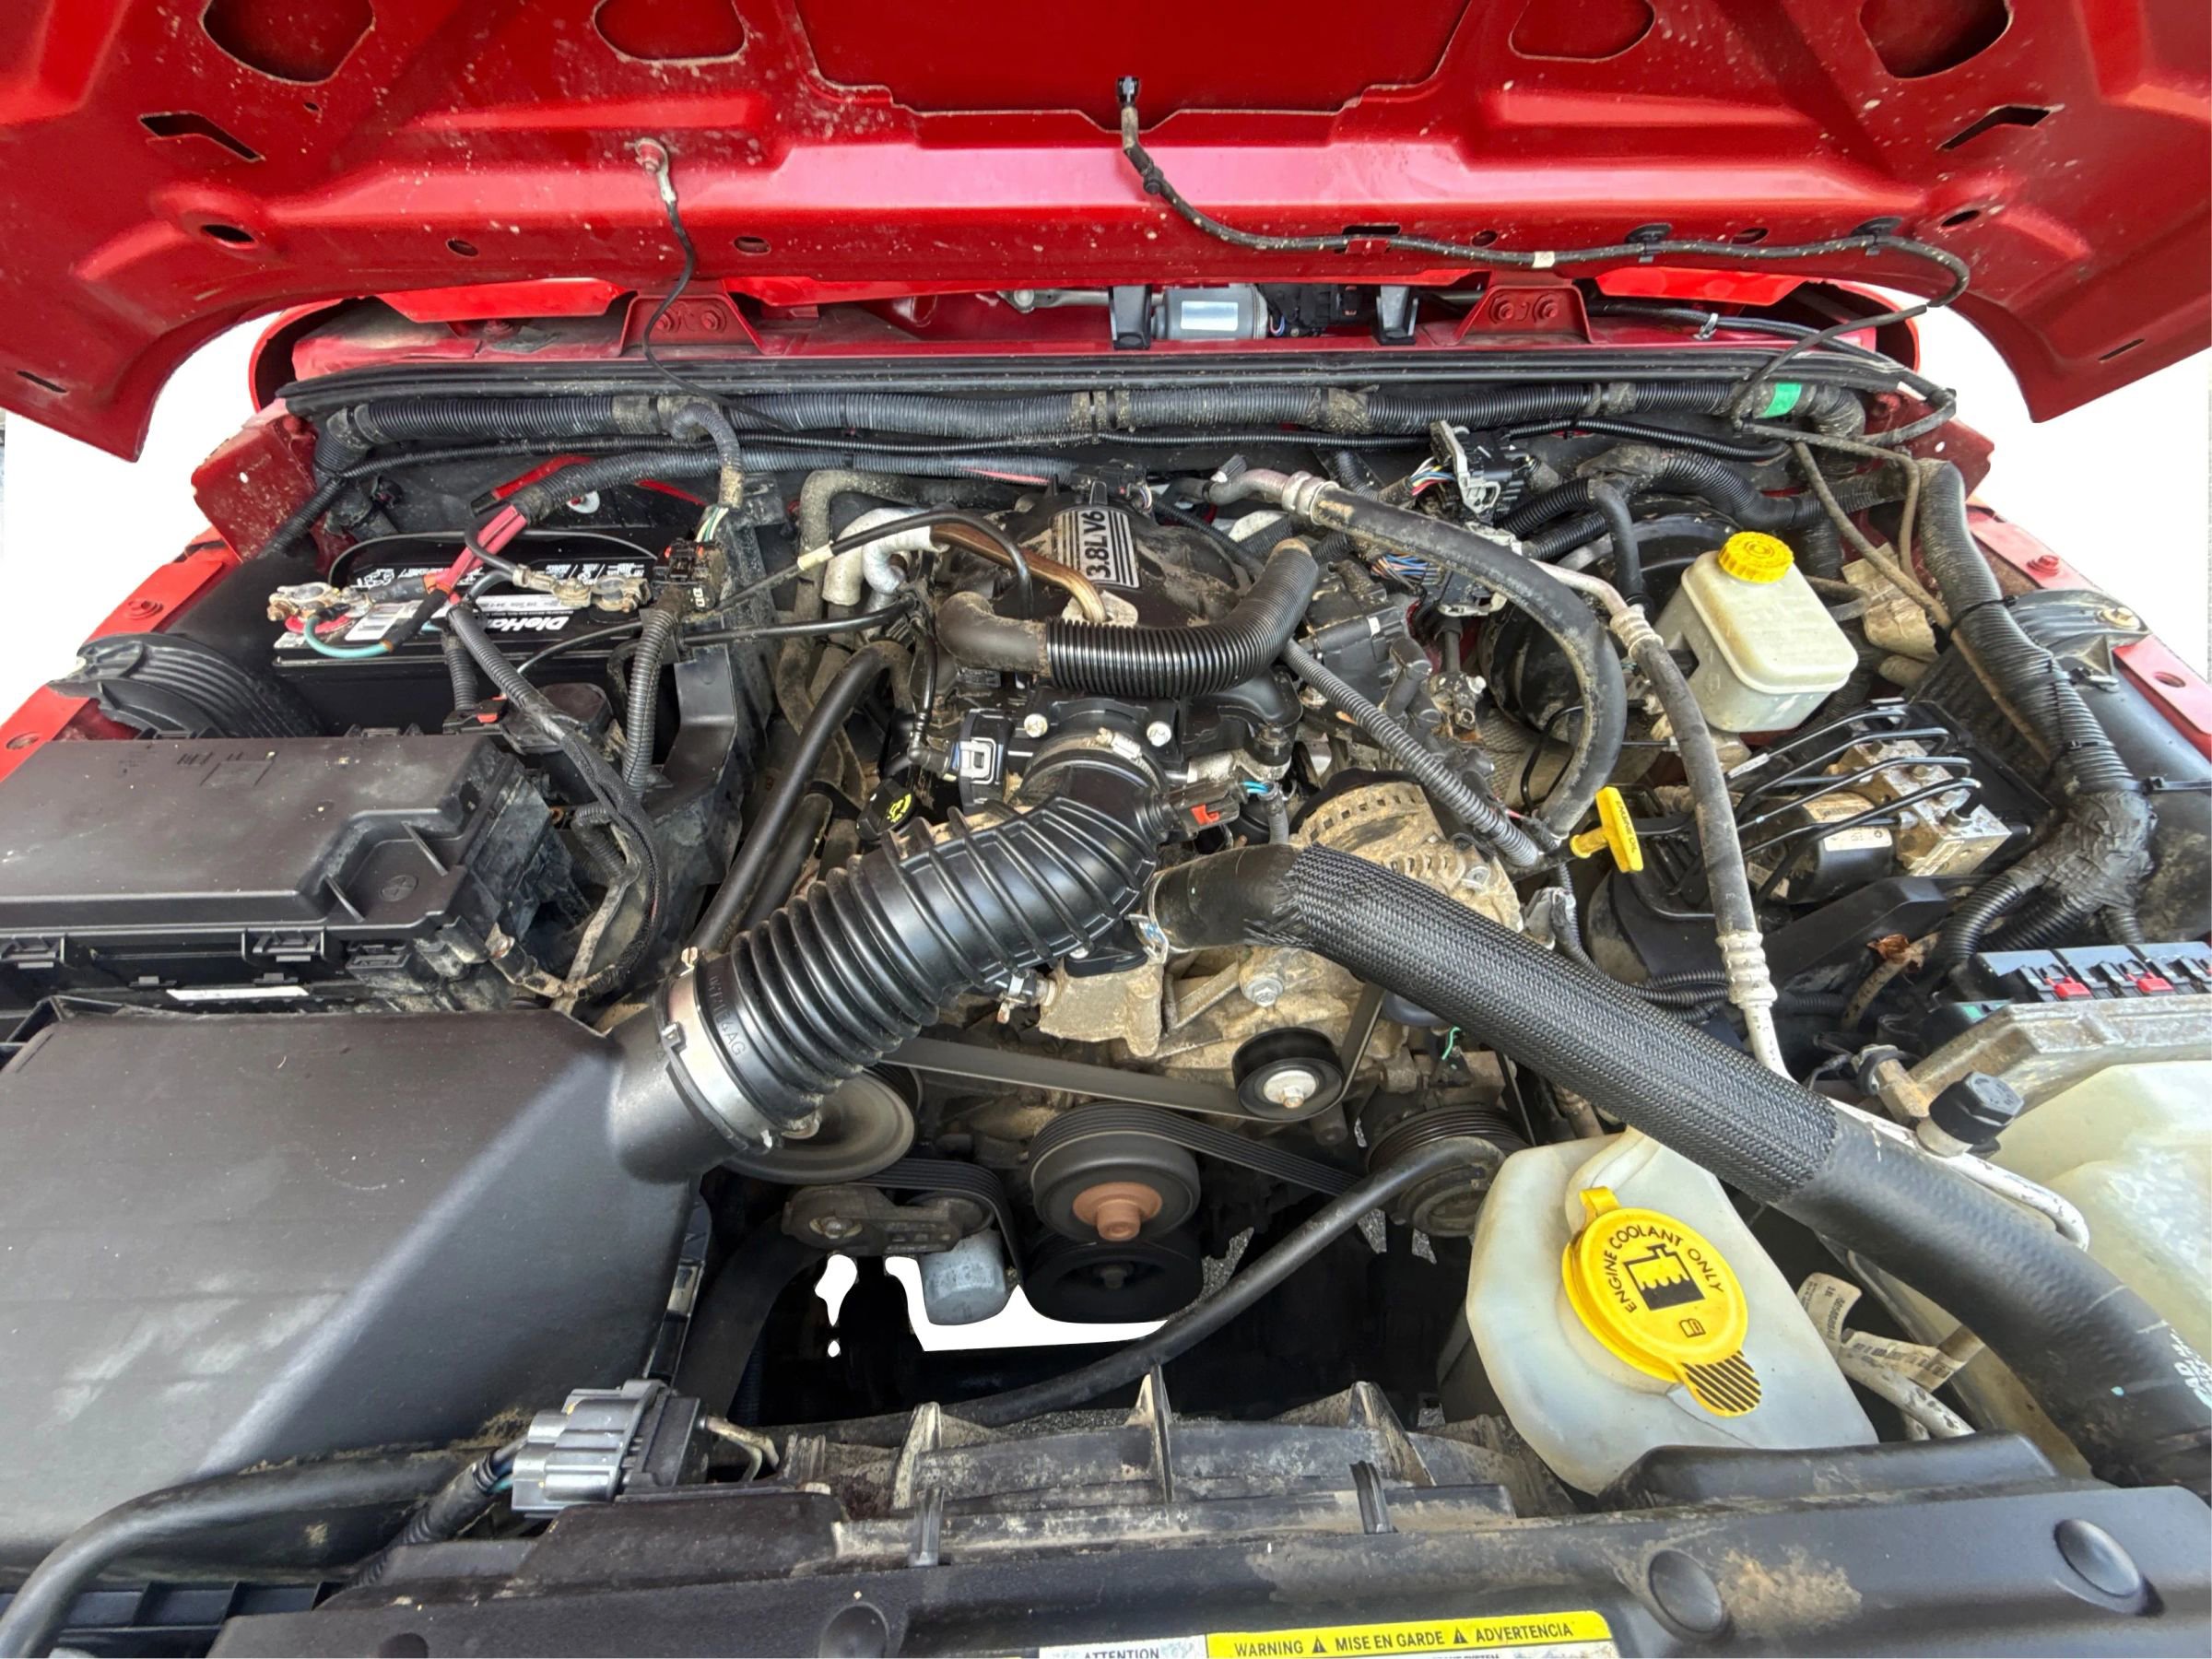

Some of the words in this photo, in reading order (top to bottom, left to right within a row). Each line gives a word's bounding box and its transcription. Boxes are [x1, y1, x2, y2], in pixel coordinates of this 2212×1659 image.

[488, 616, 570, 631] DieHa
[1629, 836, 1638, 853] OIL
[1609, 1224, 1685, 1250] COOLANT
[1604, 1250, 1638, 1313] ENGINE
[1688, 1248, 1724, 1293] ONLY
[1234, 1638, 1304, 1657] WARNING
[1335, 1635, 1371, 1652] MISE
[1375, 1634, 1394, 1650] EN
[1396, 1630, 1445, 1648] GARDE
[1476, 1622, 1574, 1642] ADVERTENCIA
[1084, 1647, 1160, 1659] ATTENTION
